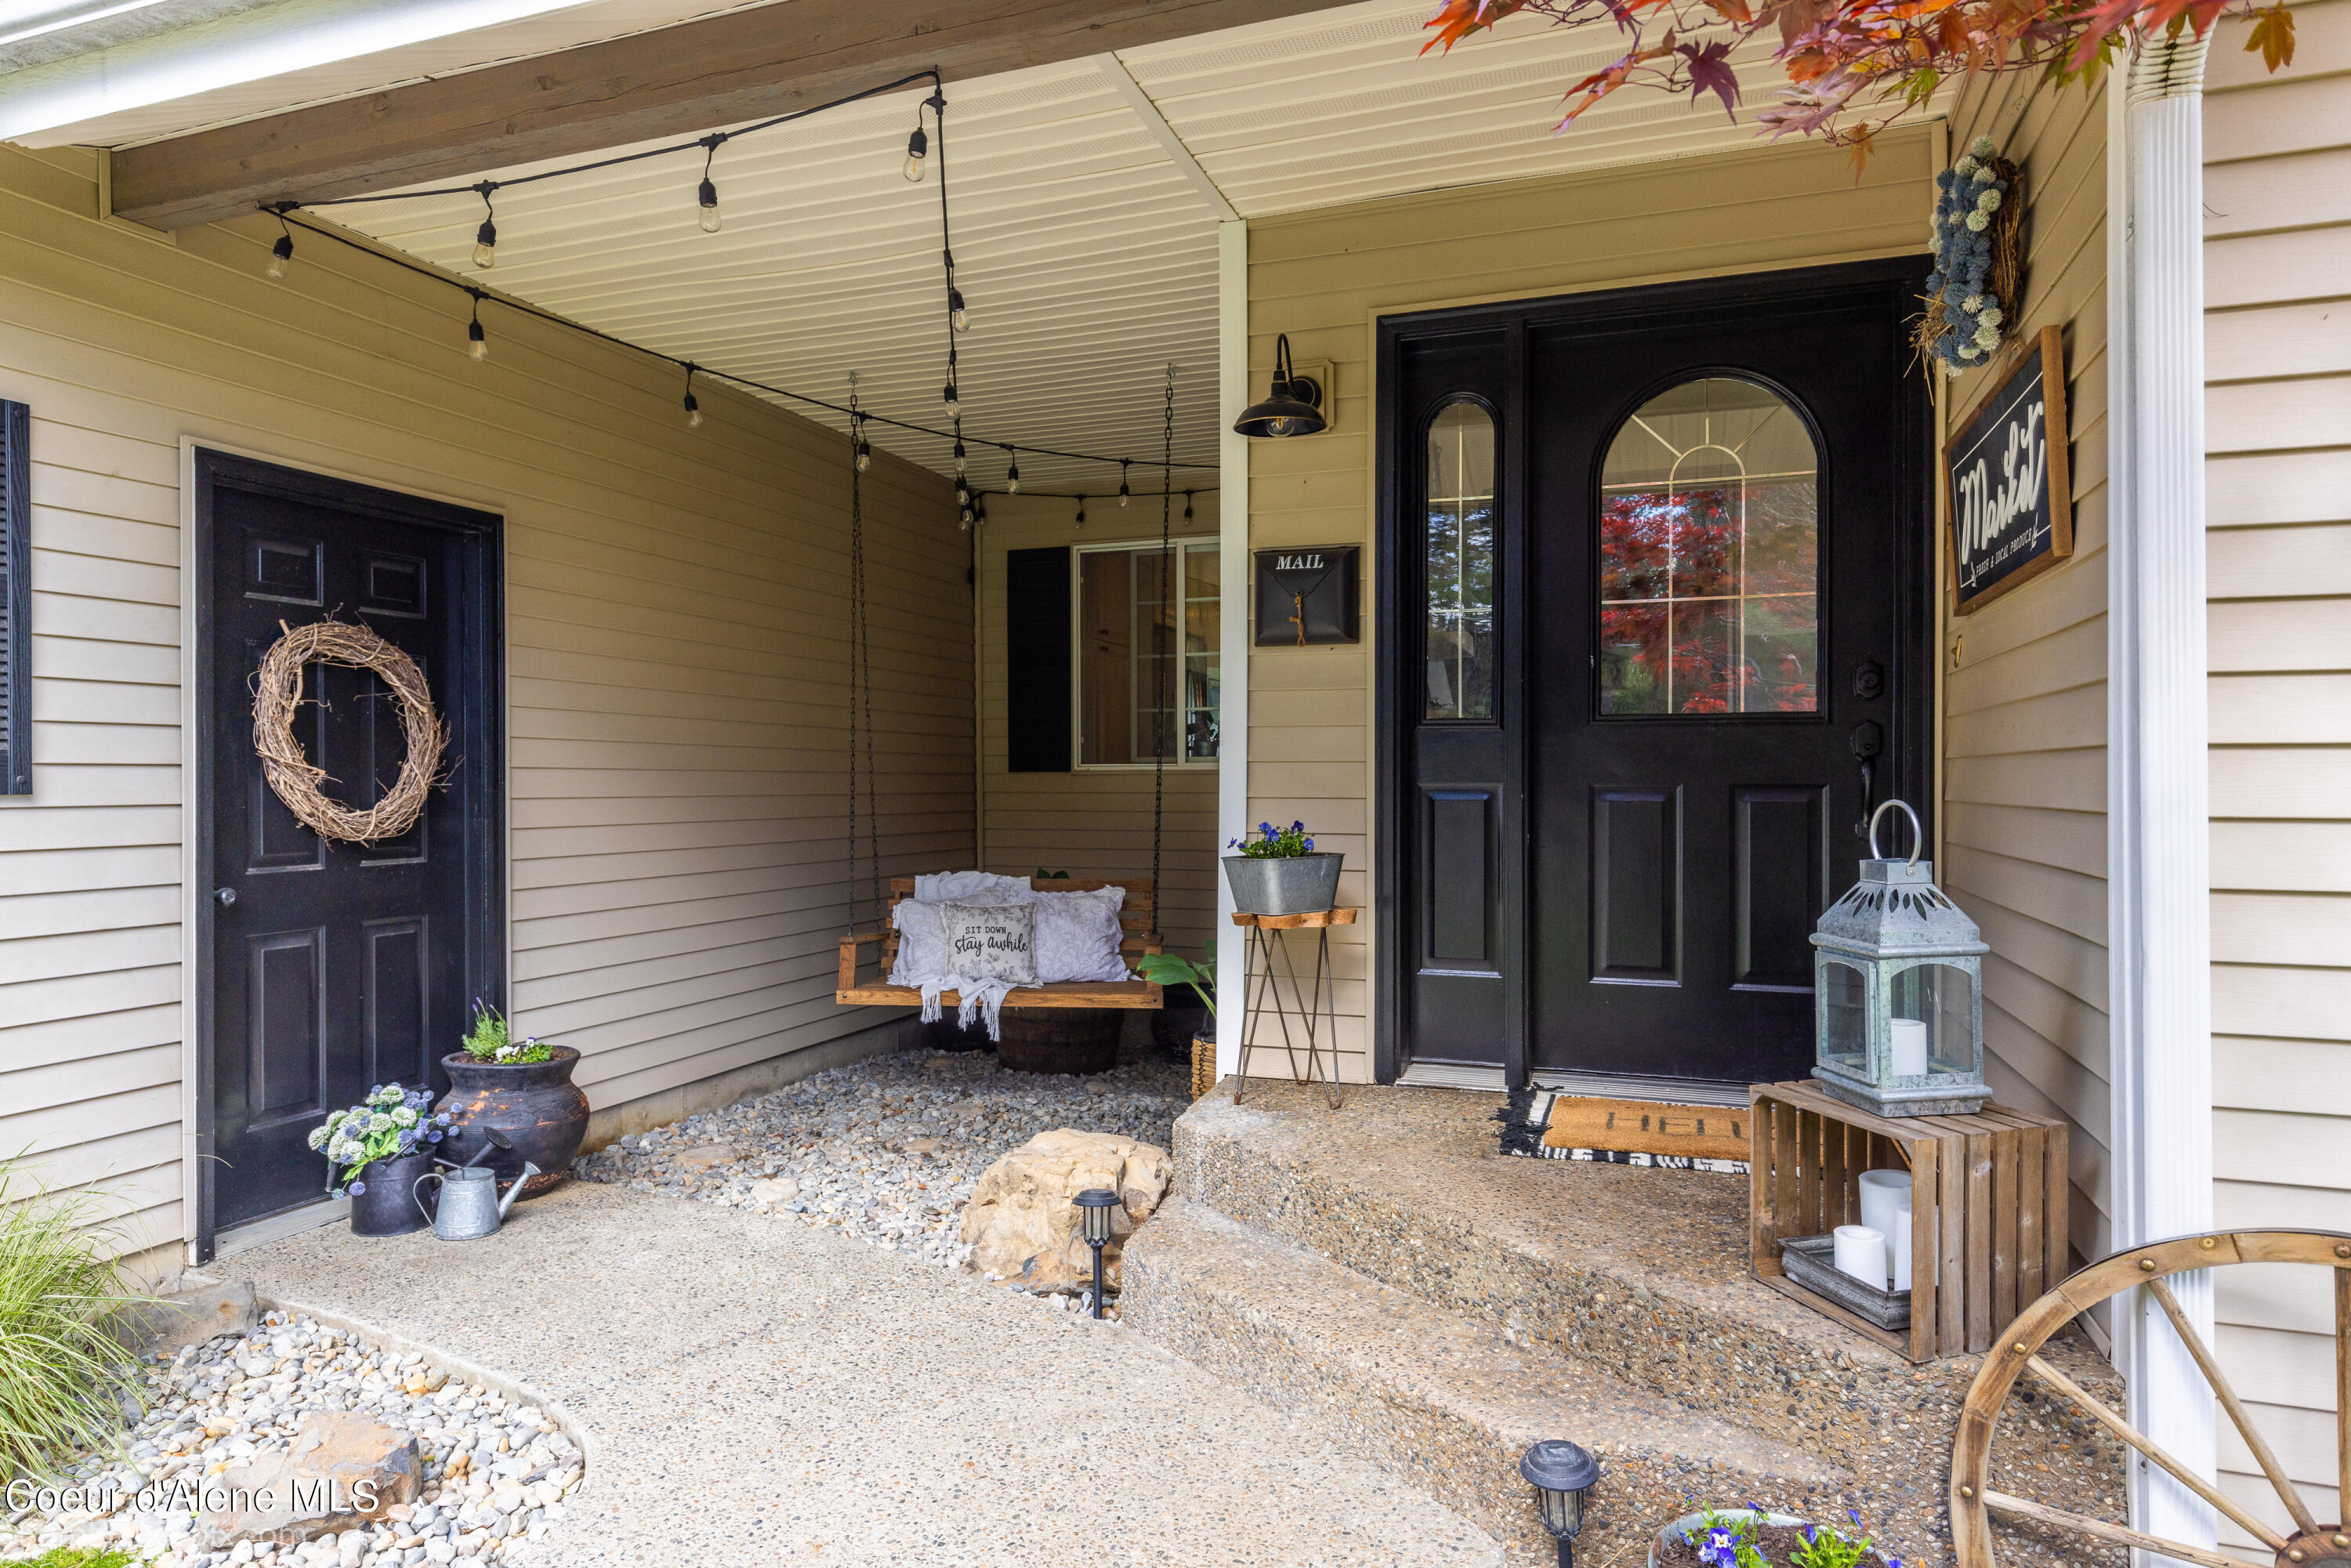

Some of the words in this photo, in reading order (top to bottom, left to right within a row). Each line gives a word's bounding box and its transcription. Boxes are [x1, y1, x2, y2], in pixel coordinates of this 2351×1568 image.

[1960, 401, 2045, 564] Market
[1276, 554, 1324, 570] MAIL
[1976, 558, 1990, 578] FRESH
[1995, 545, 2009, 564] LOCAL
[2010, 527, 2032, 555] PRODUCE
[965, 926, 982, 935] SIT
[985, 926, 1007, 935] DOWN
[955, 935, 985, 957] stay
[987, 932, 1028, 952] awhile
[1607, 1111, 1751, 1140] HELL
